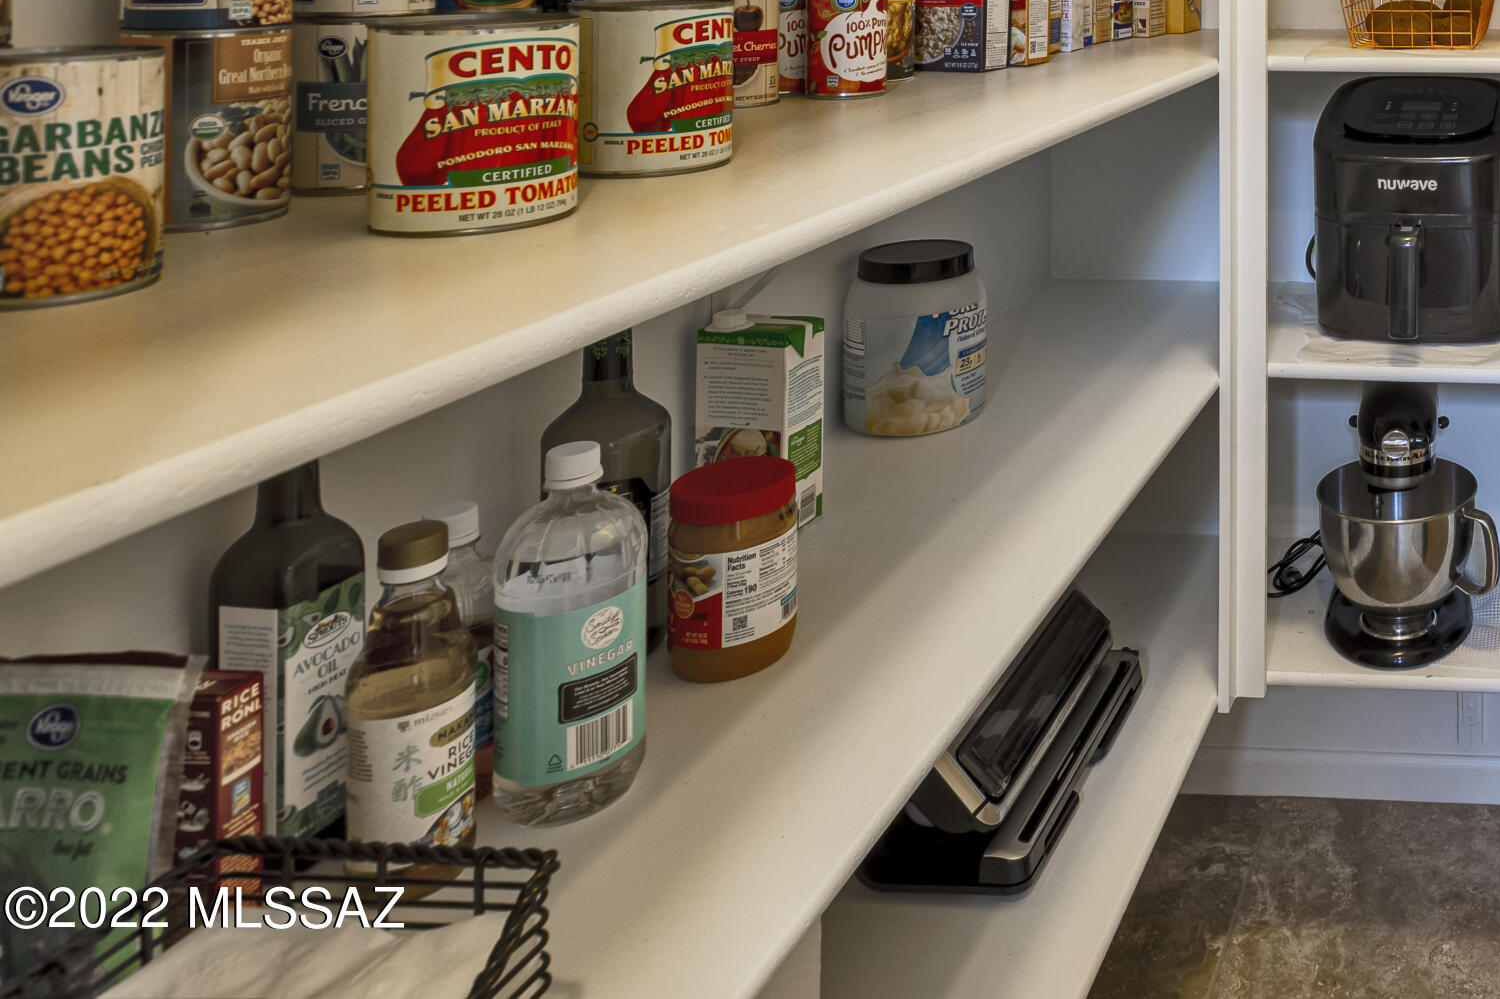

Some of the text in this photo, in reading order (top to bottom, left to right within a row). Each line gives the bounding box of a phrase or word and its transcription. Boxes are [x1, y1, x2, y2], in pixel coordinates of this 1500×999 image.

[673, 18, 733, 44] CENT
[846, 18, 871, 34] 100%
[744, 41, 777, 52] Cherries
[448, 44, 571, 78] CENTO
[218, 67, 247, 85] Great
[654, 67, 694, 94] SAN
[8, 83, 57, 111] Kroger
[307, 92, 367, 112] Frenc
[664, 98, 713, 118] POMODORO
[0, 108, 164, 154] ARBANZ
[424, 106, 479, 140] SAN
[474, 119, 562, 137] PRODUCT OF ITALY
[437, 144, 512, 169] POMODORO
[515, 142, 537, 151] SAN
[627, 133, 704, 155] PEELED
[0, 144, 134, 186] BEANS
[482, 163, 552, 183] CERTIFIED
[1377, 178, 1438, 191] nuwave
[396, 189, 496, 213] PEELED
[459, 213, 474, 222] NET
[477, 210, 490, 220] WT
[727, 552, 757, 564] Nutrition
[727, 563, 746, 572] Facts
[744, 583, 757, 594] 190
[293, 631, 361, 678] AVOCADO
[566, 639, 633, 677] VINEGAR
[317, 659, 338, 679] OIL
[221, 682, 261, 715] RICE
[448, 730, 475, 759] RICE
[56, 760, 128, 785] GRAINS
[428, 745, 475, 780] VINEG
